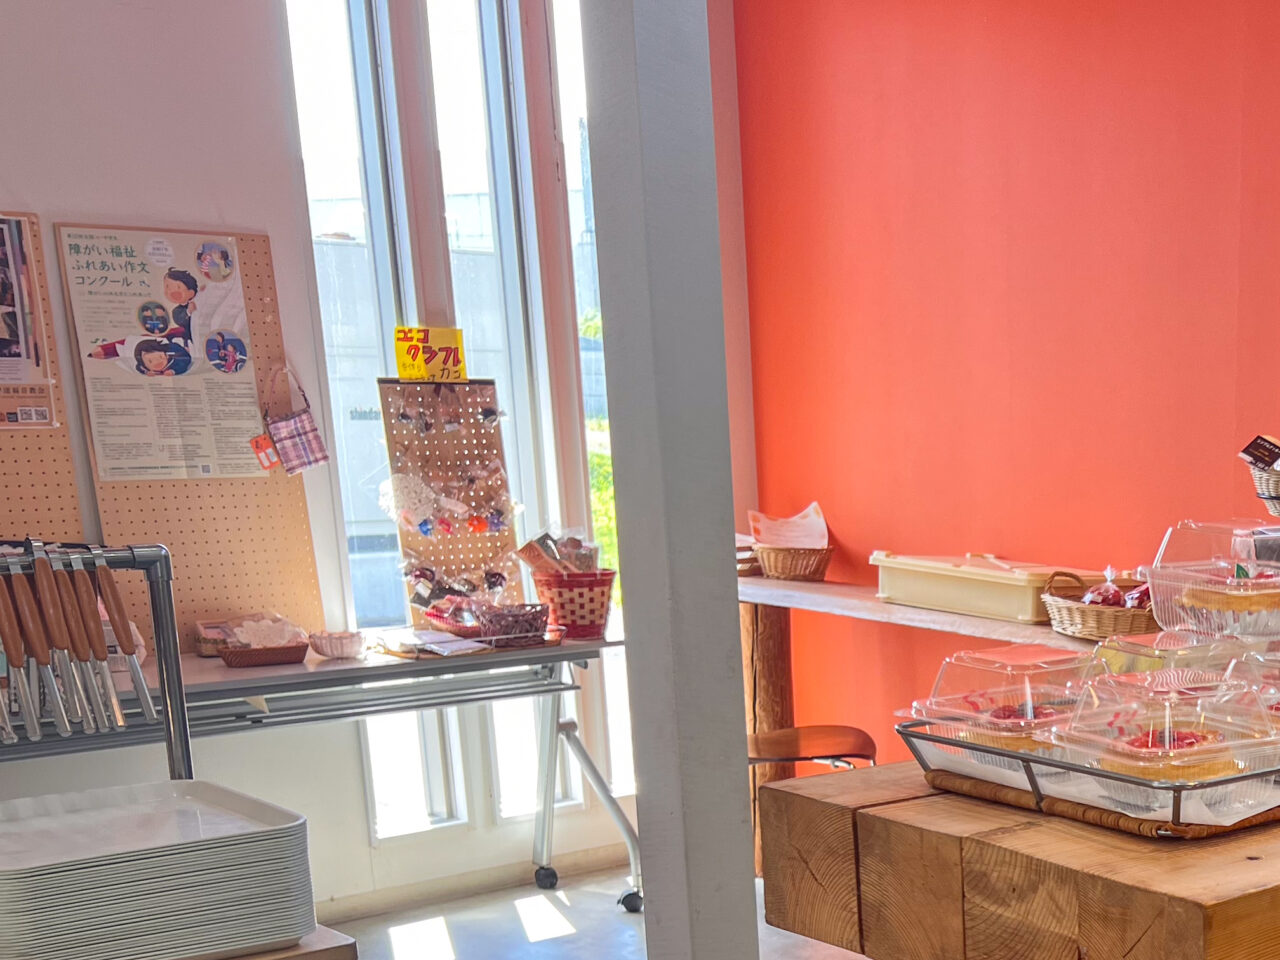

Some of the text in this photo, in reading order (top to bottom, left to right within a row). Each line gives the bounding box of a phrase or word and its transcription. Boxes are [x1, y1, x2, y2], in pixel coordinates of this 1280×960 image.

[68, 243, 137, 258] 障がい福祉
[72, 260, 151, 274] ふれあい作文
[75, 276, 133, 287] コンクール
[397, 329, 429, 344] エコ
